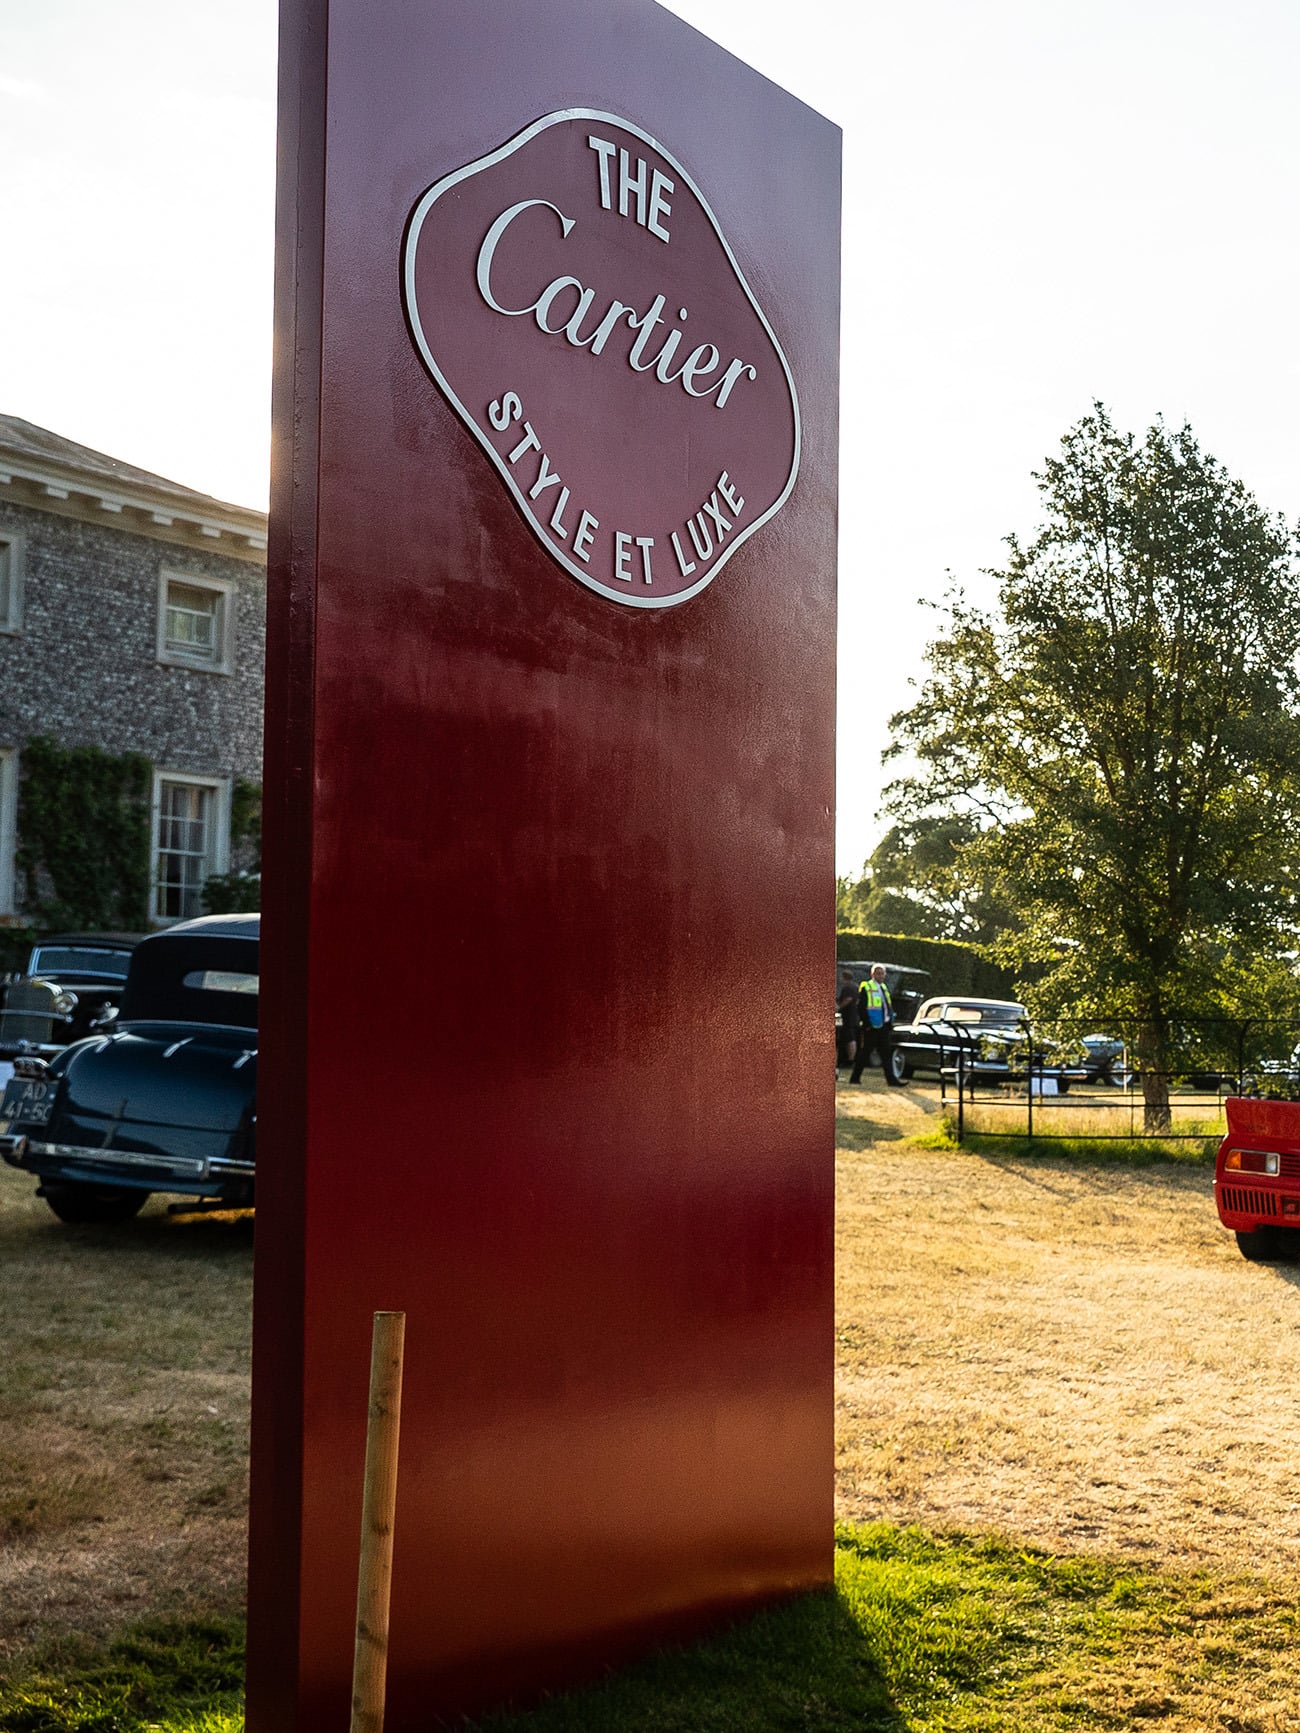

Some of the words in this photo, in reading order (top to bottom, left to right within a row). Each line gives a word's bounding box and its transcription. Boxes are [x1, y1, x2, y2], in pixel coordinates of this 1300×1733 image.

[588, 134, 675, 243] THE
[476, 199, 757, 408] Cartier
[488, 391, 600, 563] STYLE
[614, 531, 655, 584] ET
[670, 470, 745, 577] LUXE
[22, 1082, 48, 1100] AD
